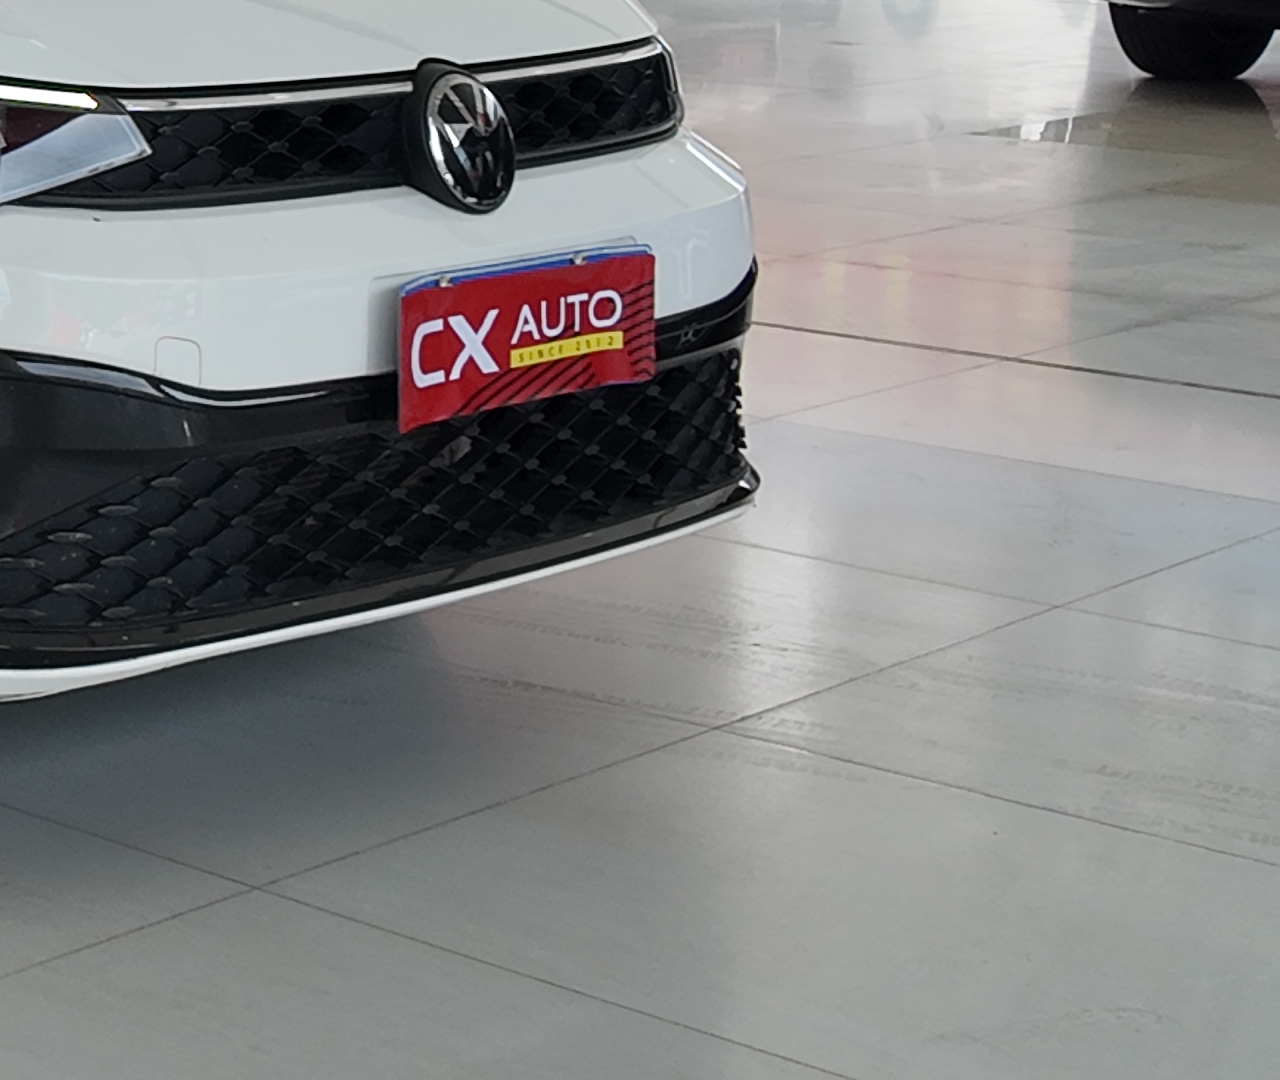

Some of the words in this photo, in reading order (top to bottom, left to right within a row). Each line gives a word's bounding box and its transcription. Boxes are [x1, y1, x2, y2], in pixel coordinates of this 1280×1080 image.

[410, 309, 500, 388] CX
[510, 289, 623, 345] AUTO
[518, 344, 564, 363] SINCE
